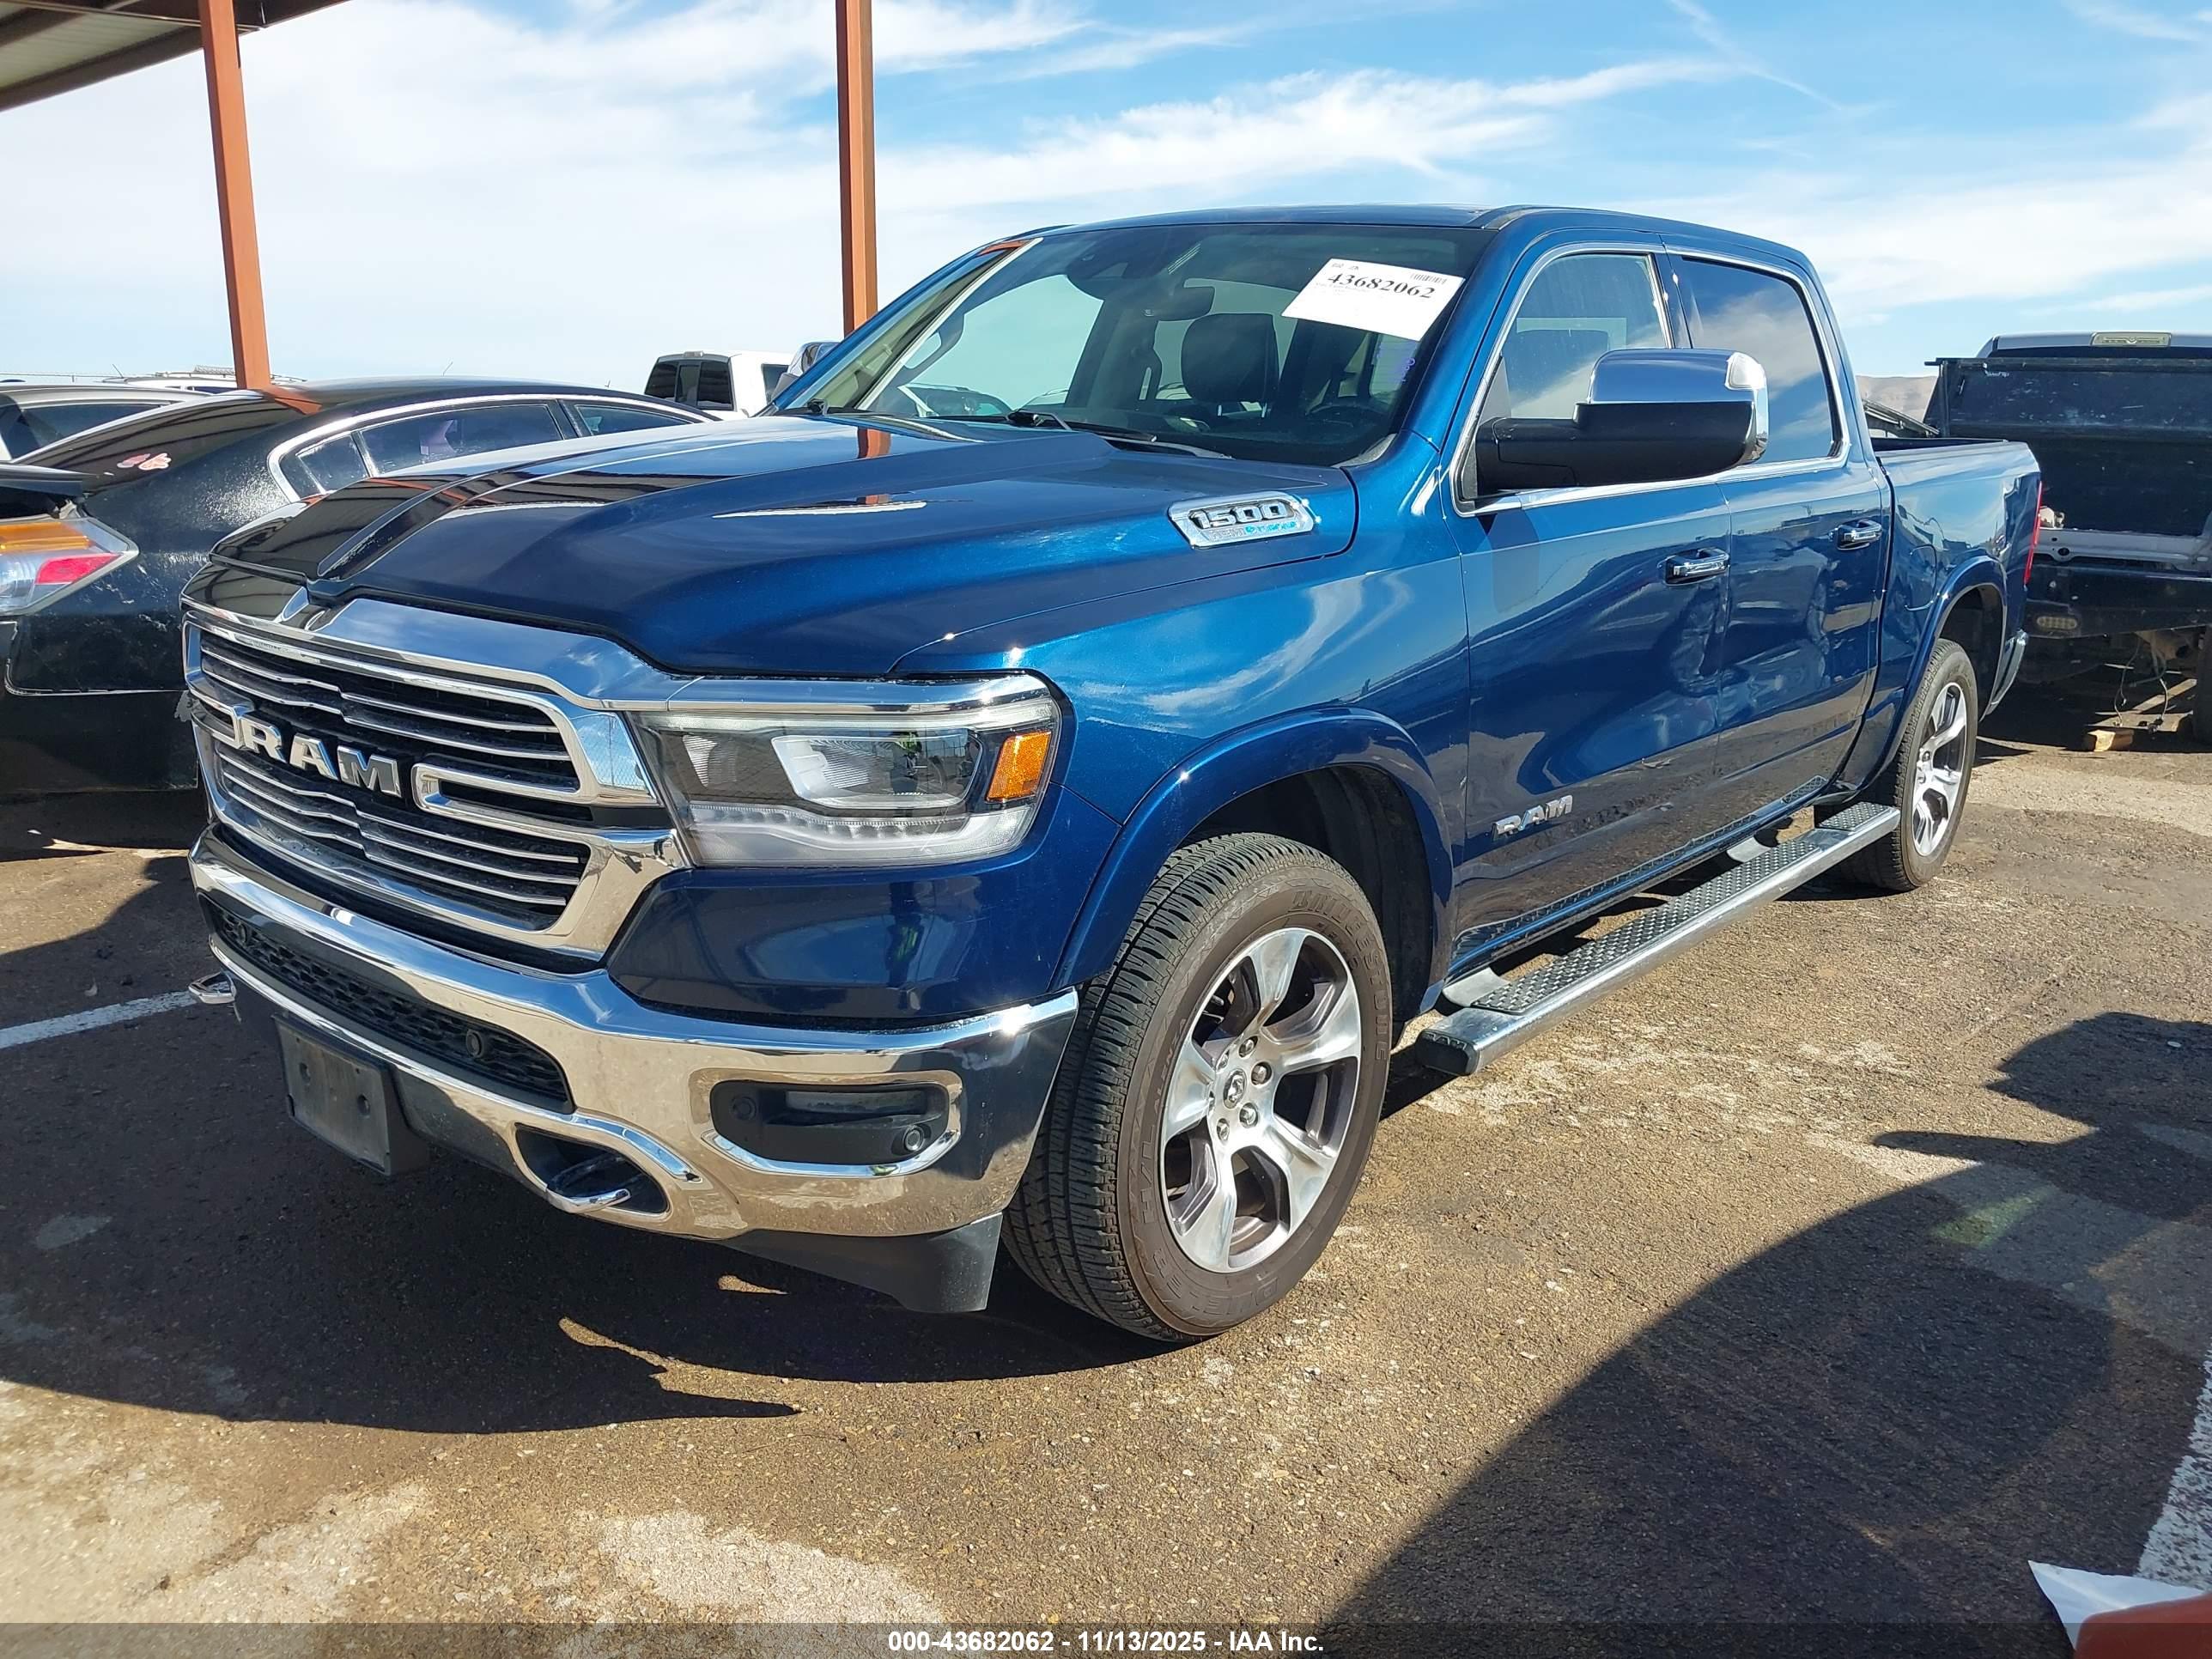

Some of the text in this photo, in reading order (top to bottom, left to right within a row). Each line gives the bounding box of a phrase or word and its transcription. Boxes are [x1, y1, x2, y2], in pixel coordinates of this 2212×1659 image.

[1328, 272, 1436, 299] 43682062
[1190, 502, 1287, 529] 1500
[241, 712, 402, 798] RAM
[1492, 795, 1573, 840] RAM
